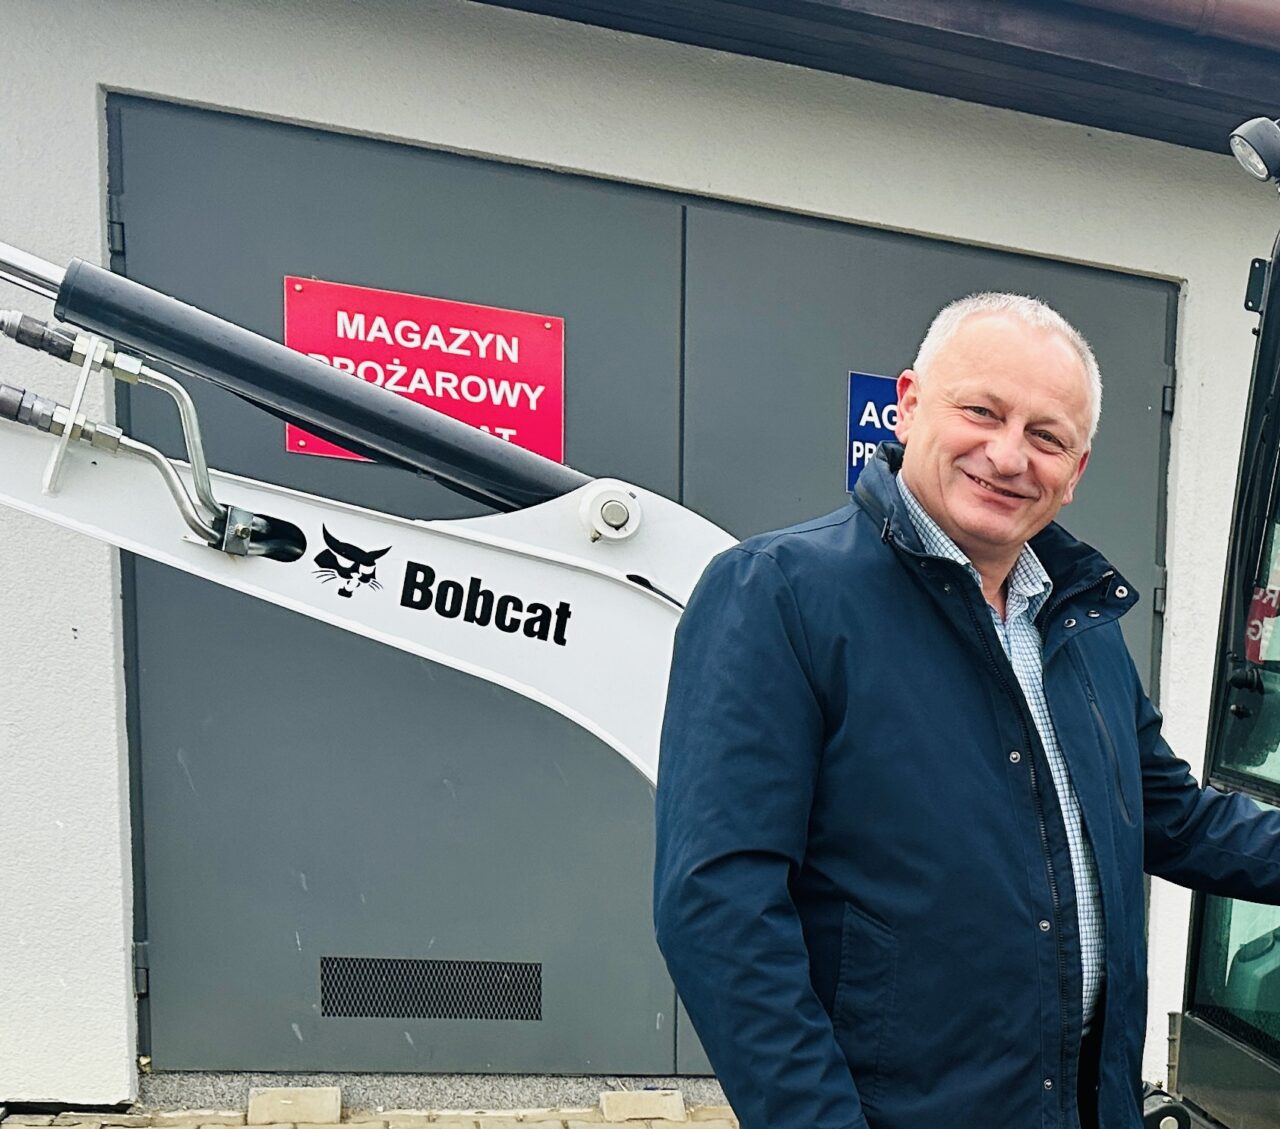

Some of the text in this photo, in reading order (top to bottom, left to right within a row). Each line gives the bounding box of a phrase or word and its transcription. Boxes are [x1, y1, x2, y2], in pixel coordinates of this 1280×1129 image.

[336, 310, 519, 364] MAGAZYN
[307, 352, 546, 411] POŻAROWY
[399, 560, 572, 647] Bobcat
